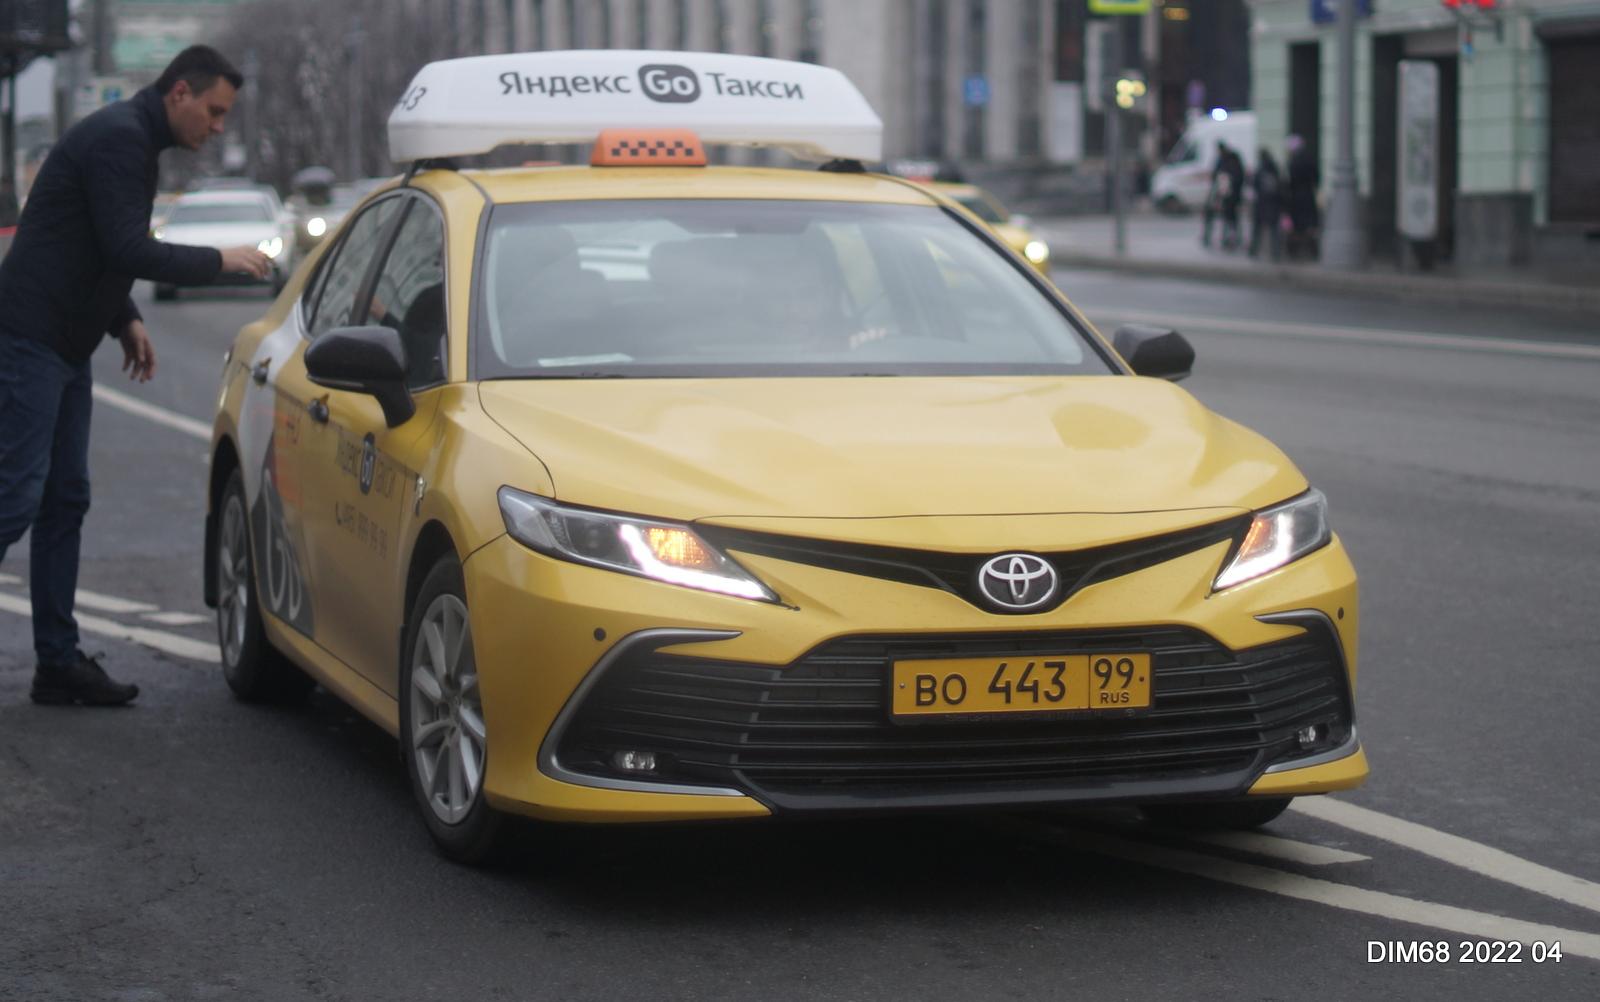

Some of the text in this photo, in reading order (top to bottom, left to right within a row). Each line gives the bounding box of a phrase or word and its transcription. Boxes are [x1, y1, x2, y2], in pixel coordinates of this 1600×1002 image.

[498, 68, 805, 101] Яндекс Go Такси
[987, 660, 1067, 705] 443
[1093, 657, 1135, 690] 99
[1099, 691, 1131, 704] RUS
